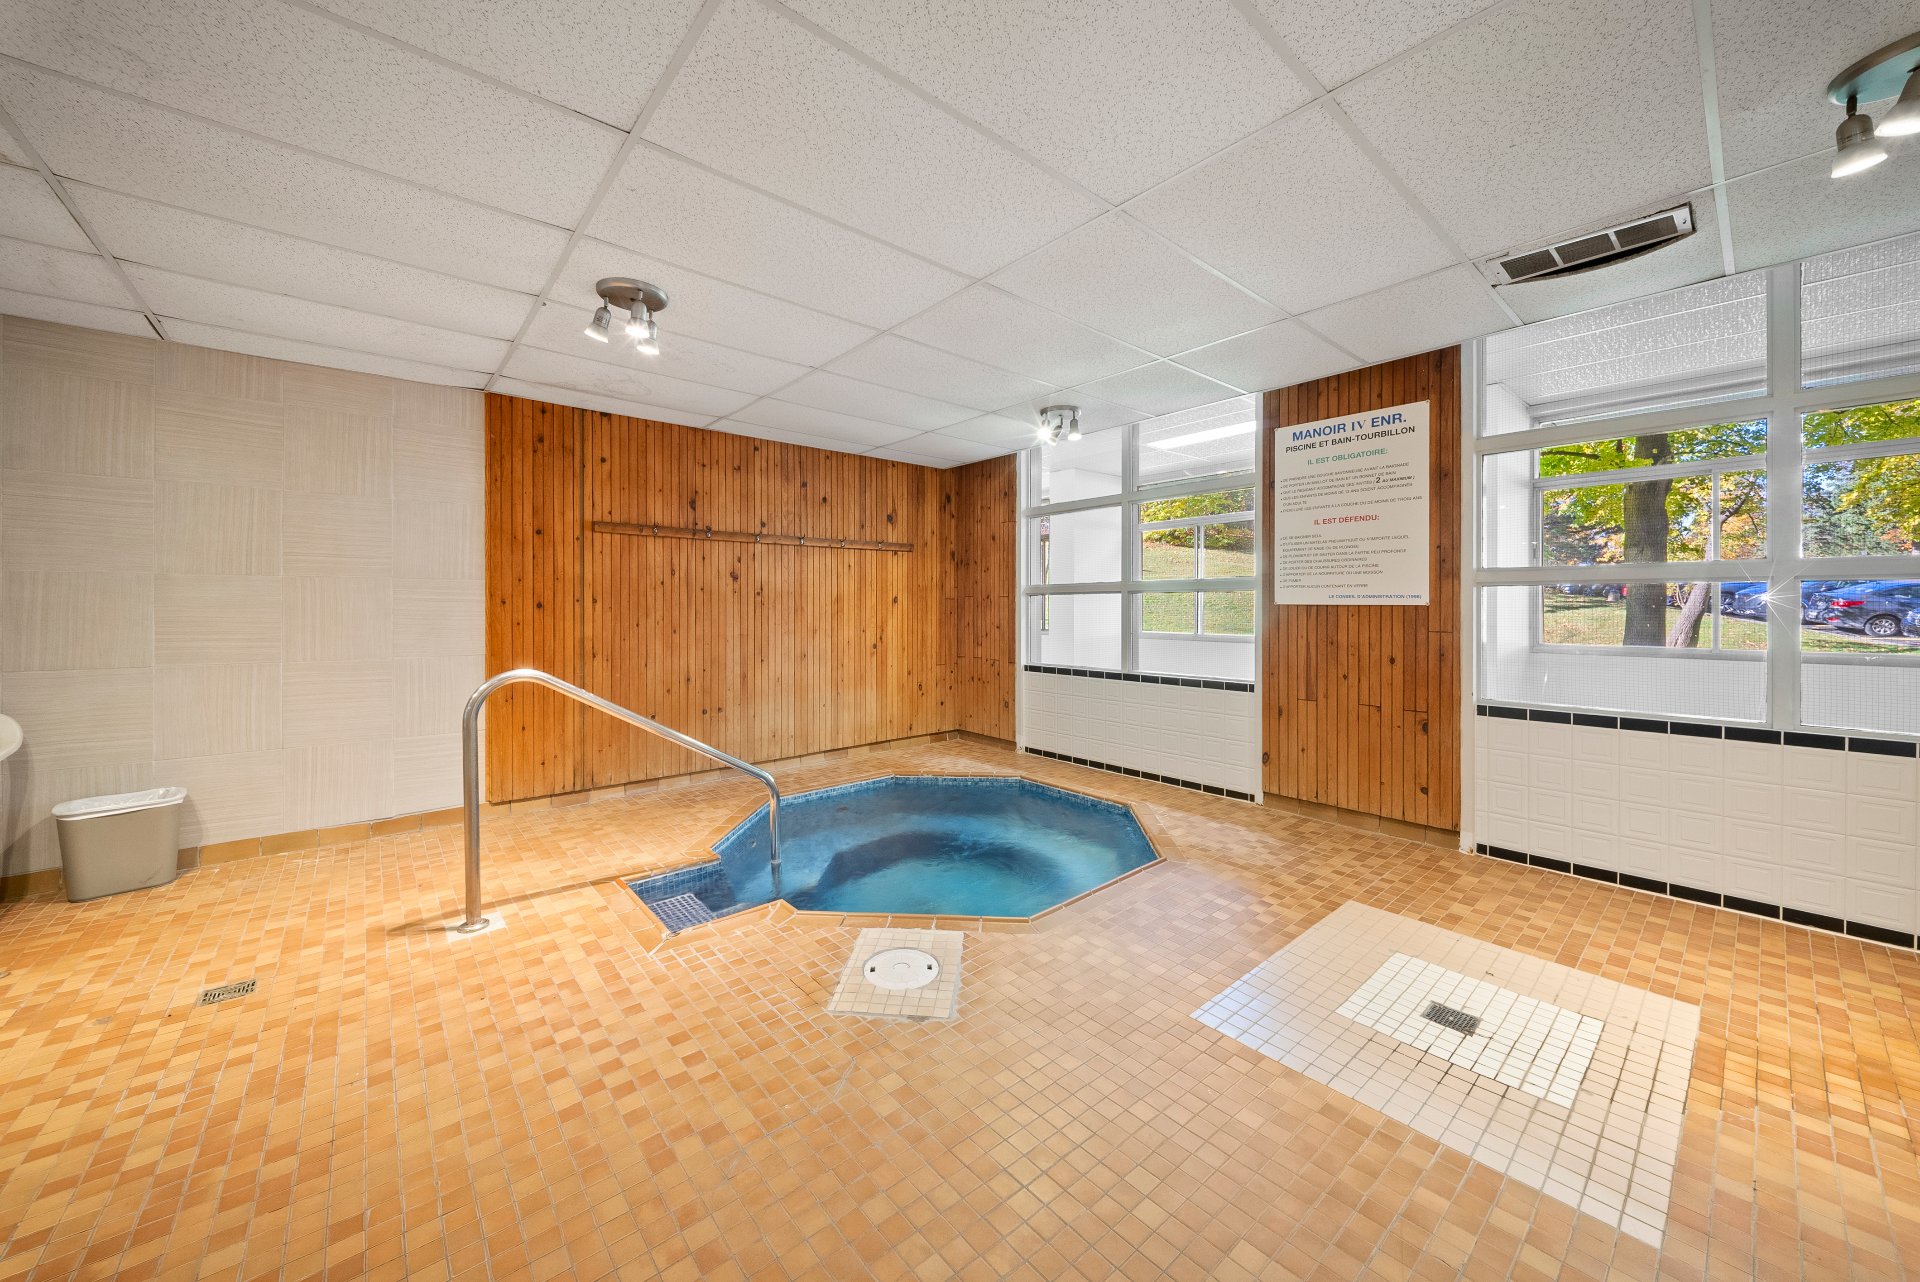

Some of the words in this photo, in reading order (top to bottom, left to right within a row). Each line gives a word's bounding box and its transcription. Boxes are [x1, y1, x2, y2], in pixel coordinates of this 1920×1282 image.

[1292, 423, 1346, 441] MANOIR
[1351, 420, 1366, 431] IV
[1371, 413, 1407, 428] ENR.
[1285, 441, 1317, 453] PISCINE
[1319, 440, 1330, 448] ET
[1331, 426, 1416, 445] BAIN-TOURBILLON
[1316, 456, 1330, 464] EST
[1332, 448, 1388, 462] OBLIGATOIRE:
[1338, 512, 1380, 523] DÉFENDU:
